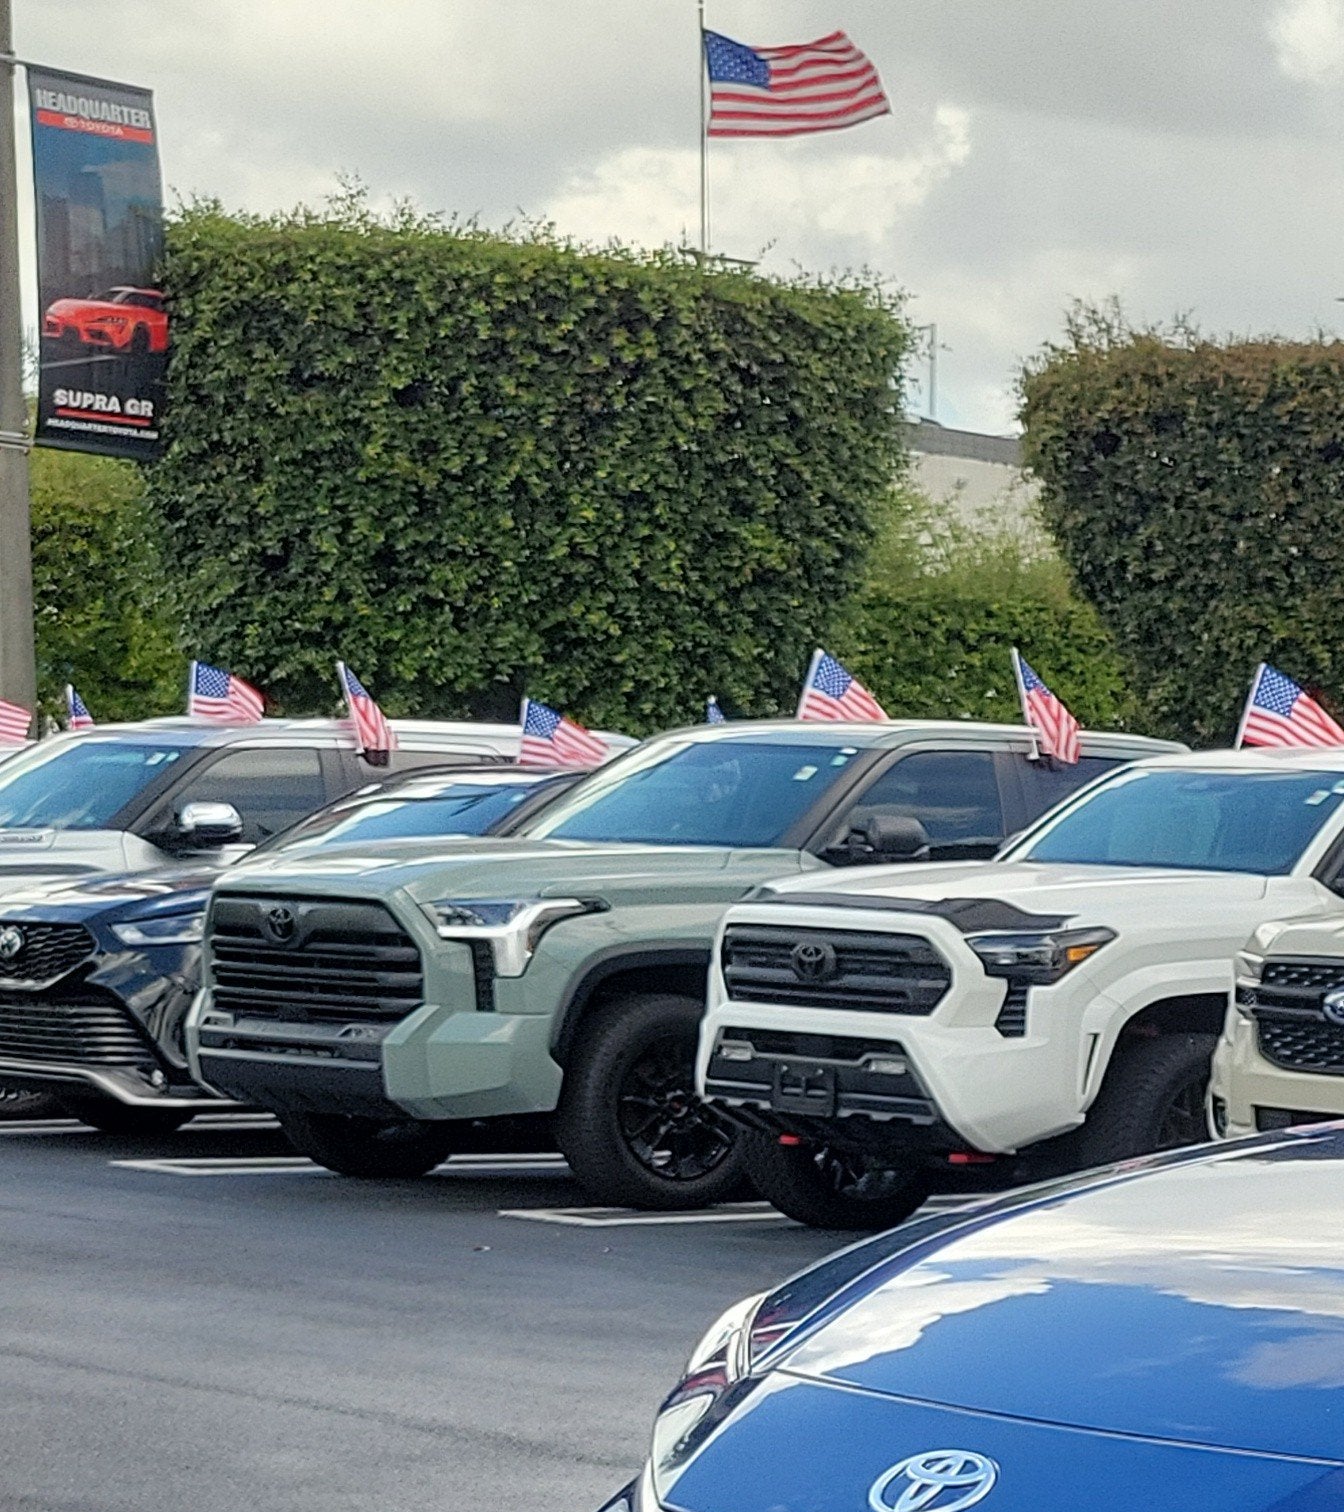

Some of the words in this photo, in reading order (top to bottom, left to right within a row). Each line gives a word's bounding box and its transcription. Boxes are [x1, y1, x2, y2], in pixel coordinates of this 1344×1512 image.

[36, 88, 151, 129] HEADQUARTER
[54, 388, 121, 413] SUPRA
[124, 398, 154, 417] GR
